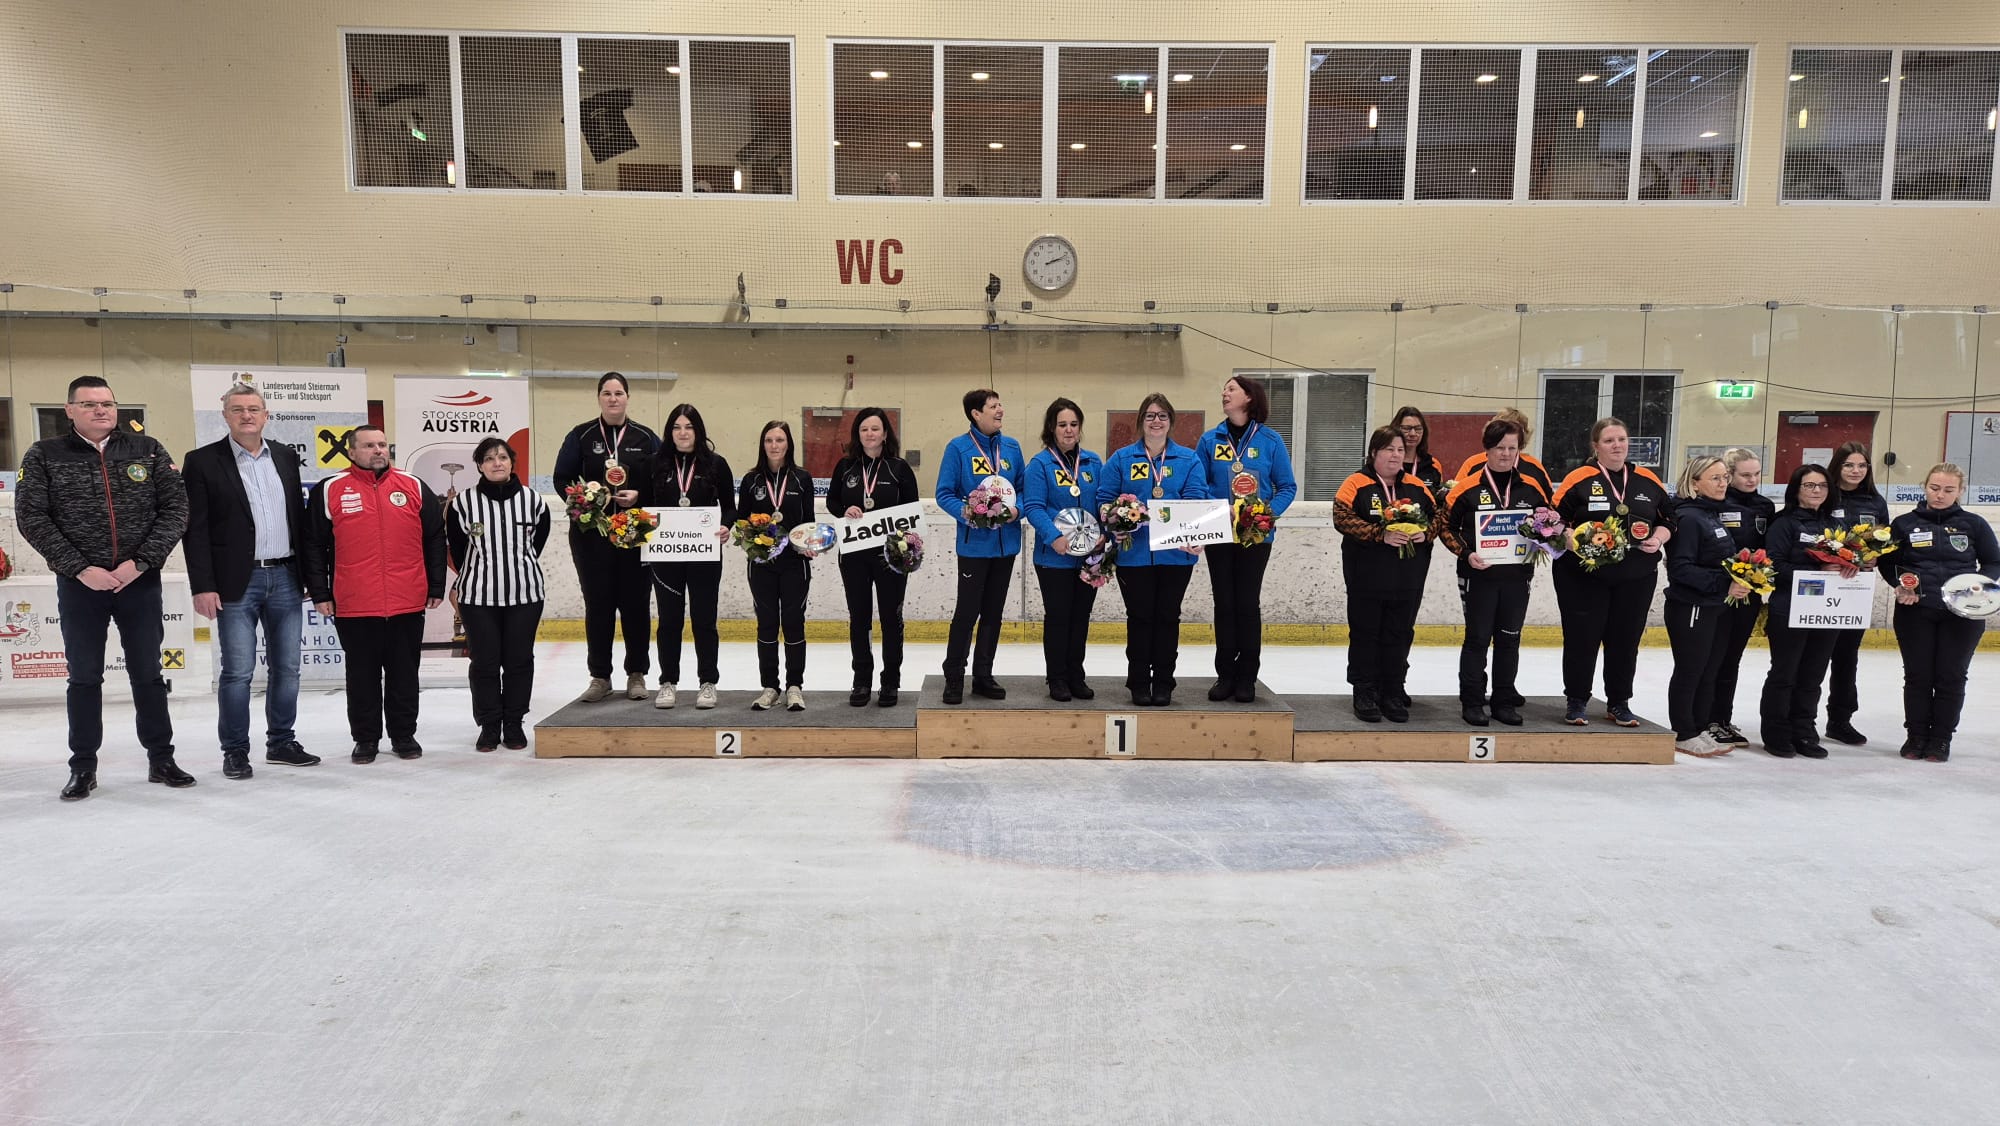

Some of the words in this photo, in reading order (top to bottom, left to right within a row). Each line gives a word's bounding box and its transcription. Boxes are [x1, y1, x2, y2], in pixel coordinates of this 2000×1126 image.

[835, 238, 904, 285] WC
[262, 381, 307, 391] Landesverband
[308, 382, 341, 391] Steiermark
[263, 391, 272, 400] für
[274, 391, 286, 400] Eis-
[287, 392, 299, 401] und
[300, 392, 332, 402] Stocksport
[276, 413, 316, 422] Sponsoren
[422, 410, 500, 420] STOCKSPORT
[422, 419, 500, 433] AUSTRIA
[842, 513, 921, 543] Ladler
[660, 531, 675, 539] ESV
[677, 531, 703, 539] Union
[649, 543, 713, 553] KROISBACH
[1826, 597, 1841, 607] SV
[45, 616, 60, 624] für
[1799, 614, 1863, 625] HERNSTEIN
[1113, 719, 1127, 753] 1
[720, 732, 736, 755] 2
[1475, 737, 1489, 759] 3
